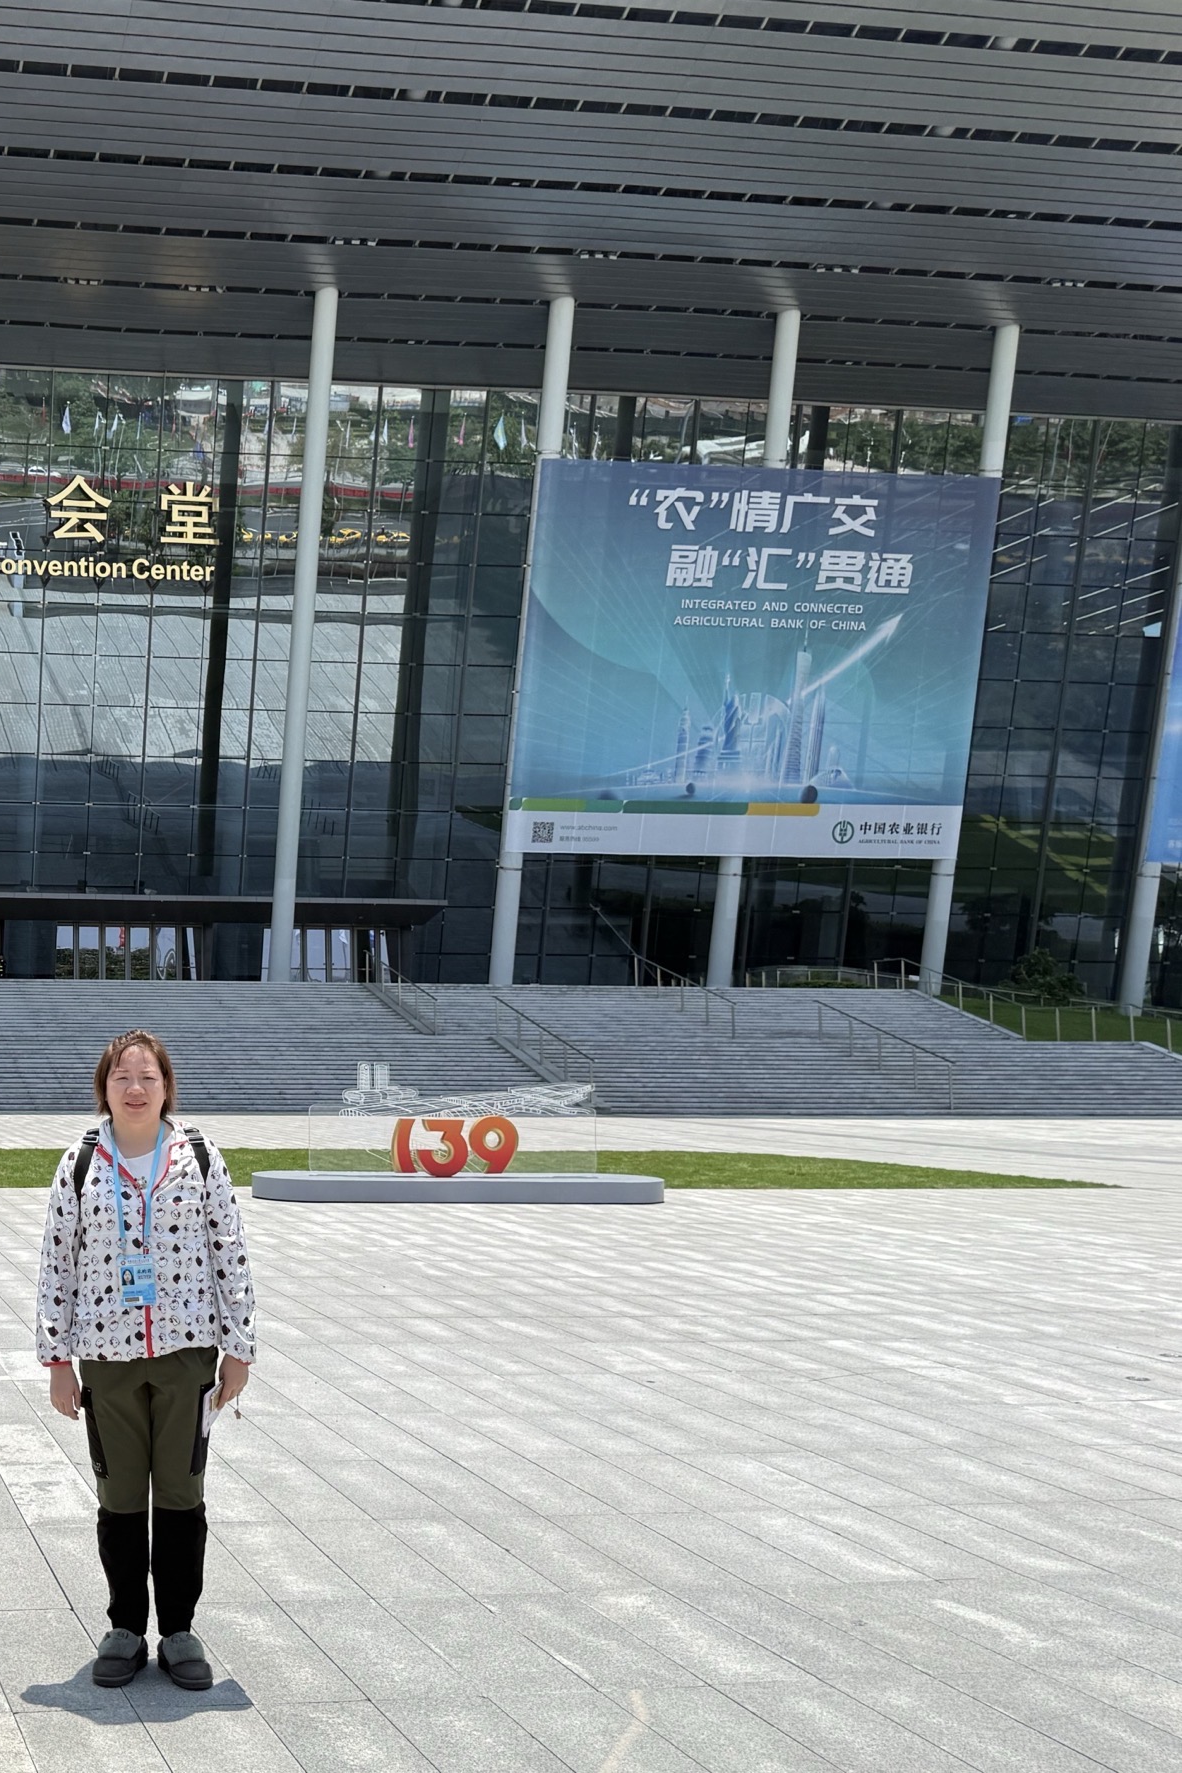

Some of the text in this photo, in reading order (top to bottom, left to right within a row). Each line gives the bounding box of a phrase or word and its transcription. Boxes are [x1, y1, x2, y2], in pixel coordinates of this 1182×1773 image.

[628, 487, 879, 537] “农”情广交
[132, 558, 215, 582] Center
[665, 544, 914, 594] 融“汇”贯通
[680, 598, 864, 615] INTEGRATED AND CONNECTED
[673, 615, 867, 632] AGRICULTURAL BANK OF CHINA
[859, 821, 943, 836] 中国农业银行
[391, 1115, 520, 1177] 139
